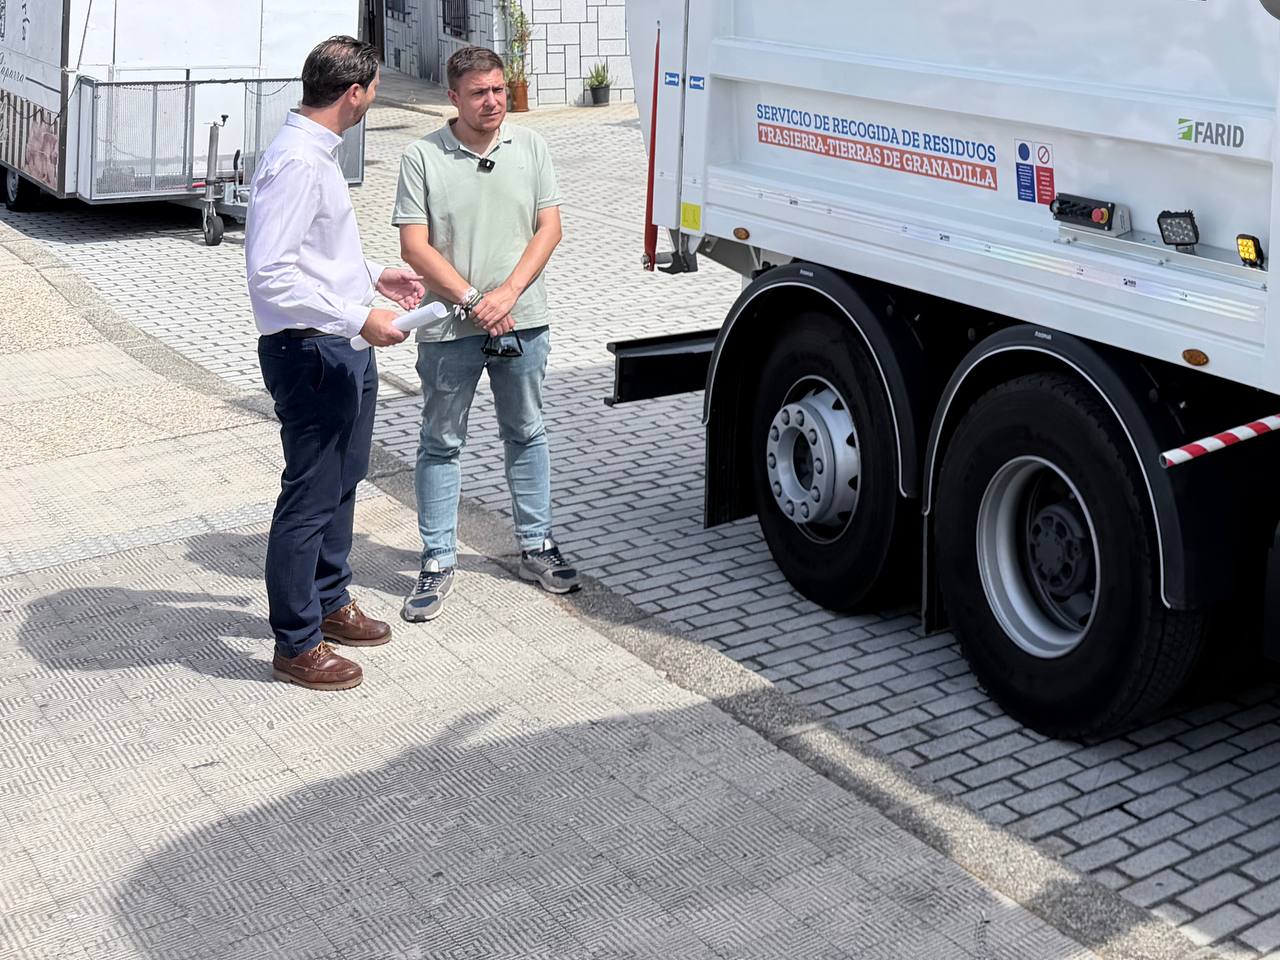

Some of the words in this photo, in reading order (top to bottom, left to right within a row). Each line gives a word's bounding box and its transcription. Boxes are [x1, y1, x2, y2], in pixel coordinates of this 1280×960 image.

[757, 103, 811, 127] SERVICIO
[814, 113, 830, 131] DE
[832, 118, 898, 141] RECOGIDA
[902, 130, 919, 148] DE
[920, 134, 996, 162] RESIDUOS
[759, 125, 881, 164] TRASIERRA-TIERRAS
[884, 150, 901, 168] DE
[903, 154, 996, 188] GRANADILLA
[1194, 121, 1244, 148] FARID
